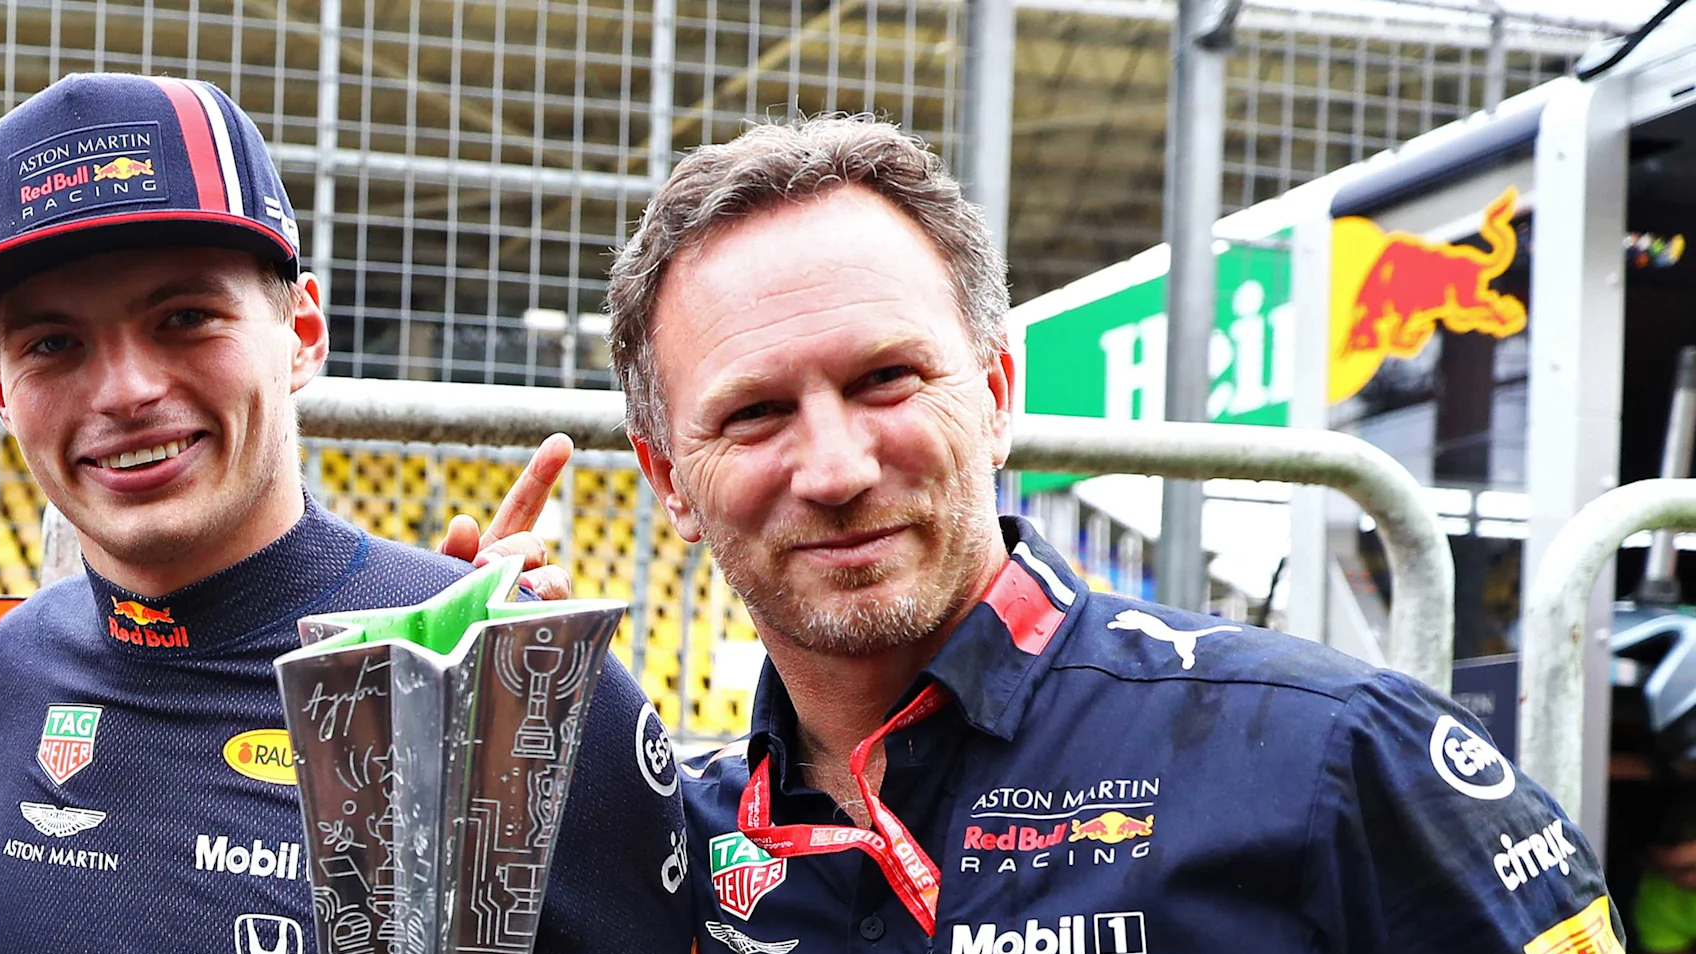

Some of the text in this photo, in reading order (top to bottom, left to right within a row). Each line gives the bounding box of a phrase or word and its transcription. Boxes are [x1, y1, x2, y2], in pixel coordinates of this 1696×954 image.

[18, 132, 151, 175] ASTON MARTIN
[20, 165, 90, 204] Red Bull
[22, 179, 157, 219] RACING
[108, 617, 189, 648] Red Bull
[51, 711, 94, 736] TAG
[41, 740, 91, 777] HEUER
[254, 744, 294, 768] RAU
[971, 777, 1160, 811] ASTON MARTIN
[712, 835, 770, 867] TA
[833, 829, 886, 850] GRID
[963, 821, 1068, 851] Red Bull
[2, 838, 120, 872] ASTON MARTIN
[194, 834, 300, 880] Mobil
[959, 840, 1152, 874] RACING
[713, 861, 783, 912] HEUER
